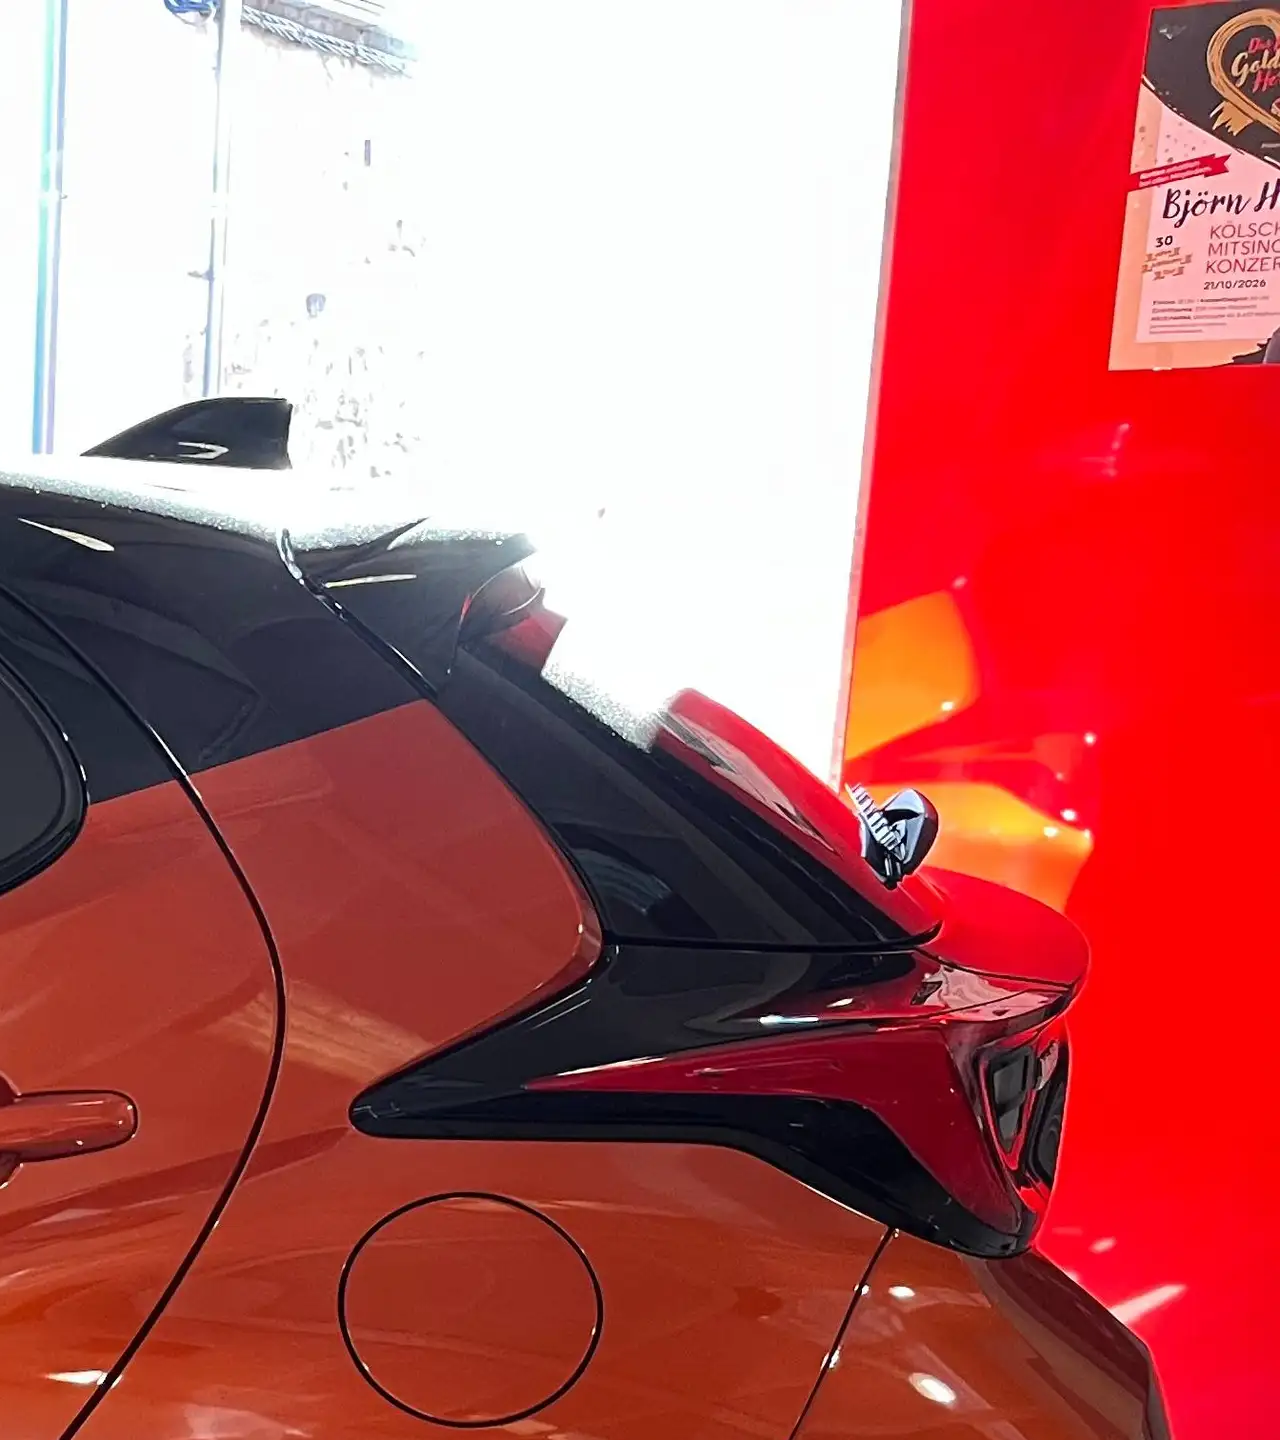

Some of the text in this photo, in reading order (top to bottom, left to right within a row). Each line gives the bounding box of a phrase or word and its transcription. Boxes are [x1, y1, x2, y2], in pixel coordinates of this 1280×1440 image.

[1163, 187, 1252, 228] Björn
[1155, 235, 1173, 248] 30
[1203, 279, 1267, 290] 21/10/2026
